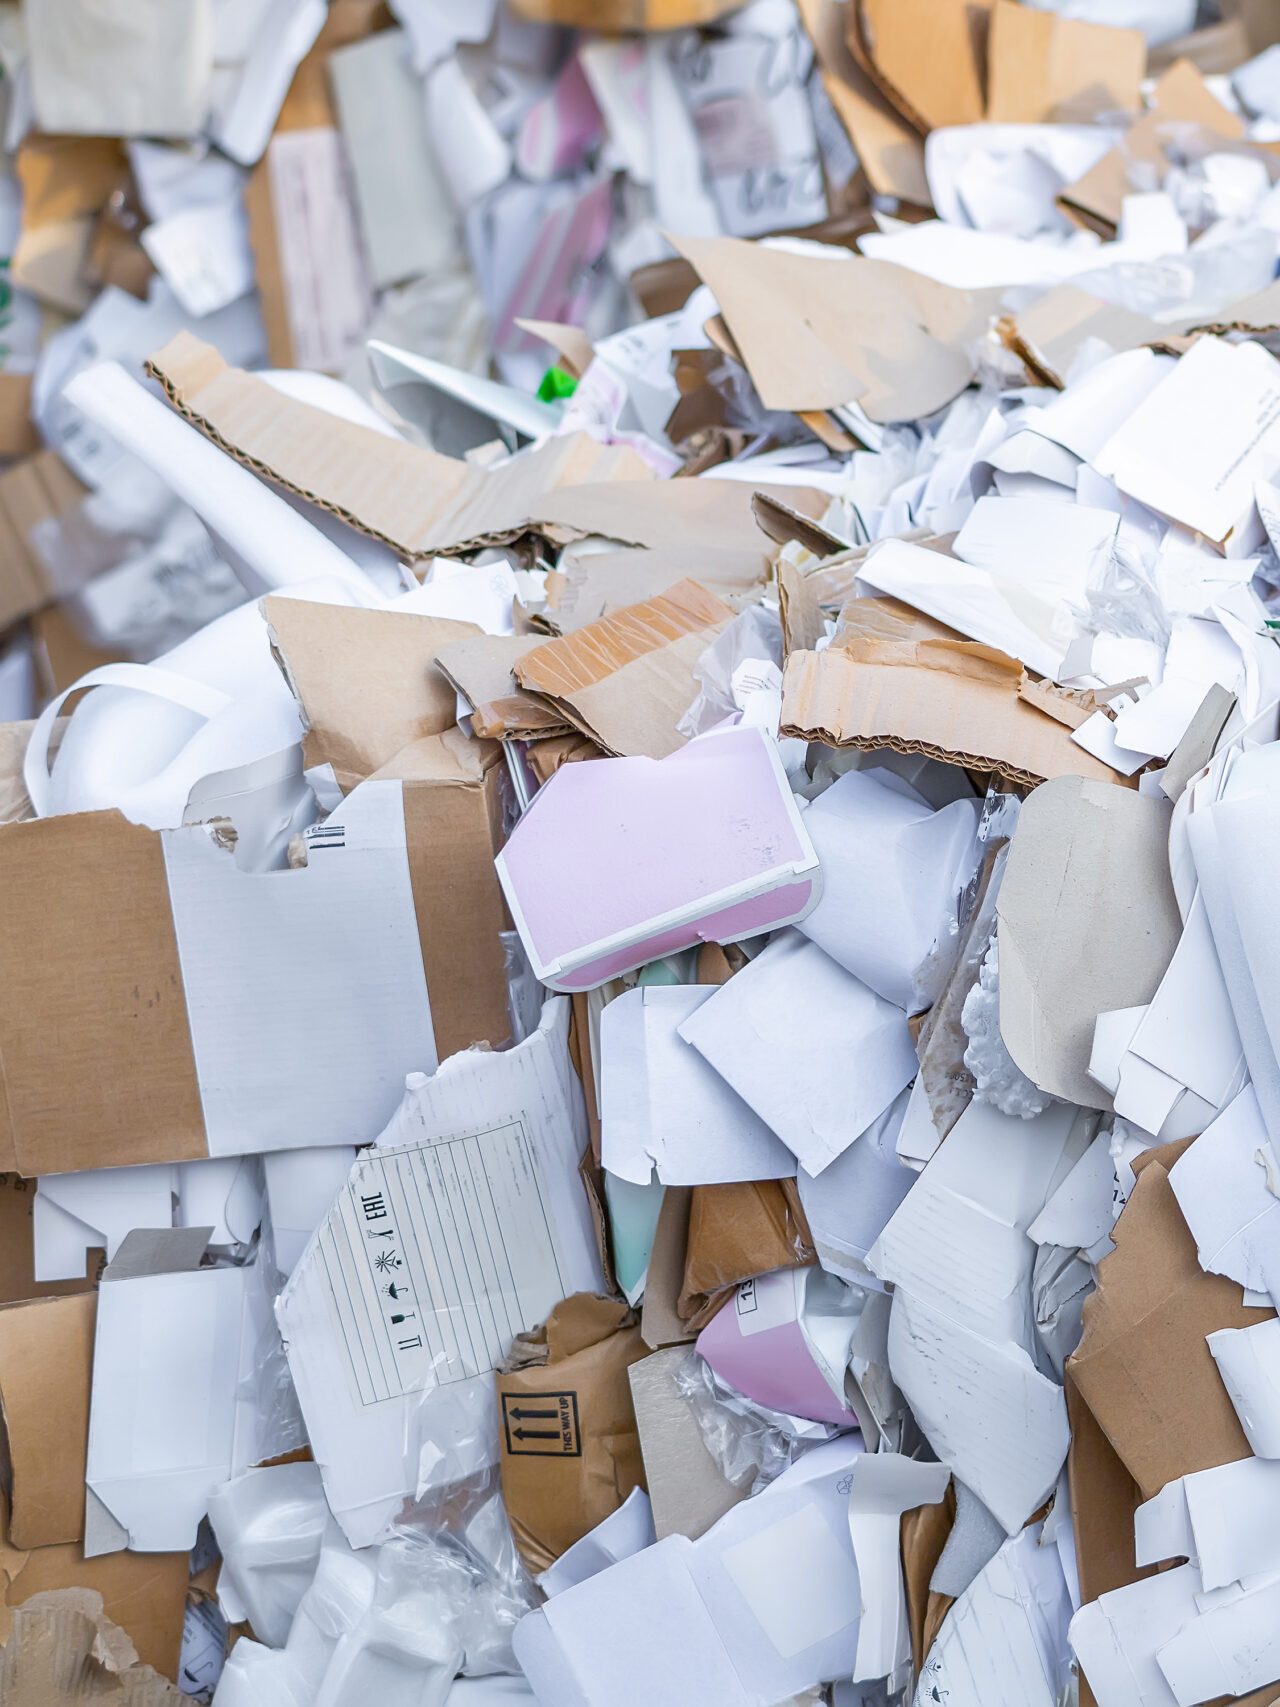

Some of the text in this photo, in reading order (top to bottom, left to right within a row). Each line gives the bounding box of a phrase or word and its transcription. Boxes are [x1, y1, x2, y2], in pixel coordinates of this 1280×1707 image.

[559, 1396, 573, 1452] THIS WAY UP
